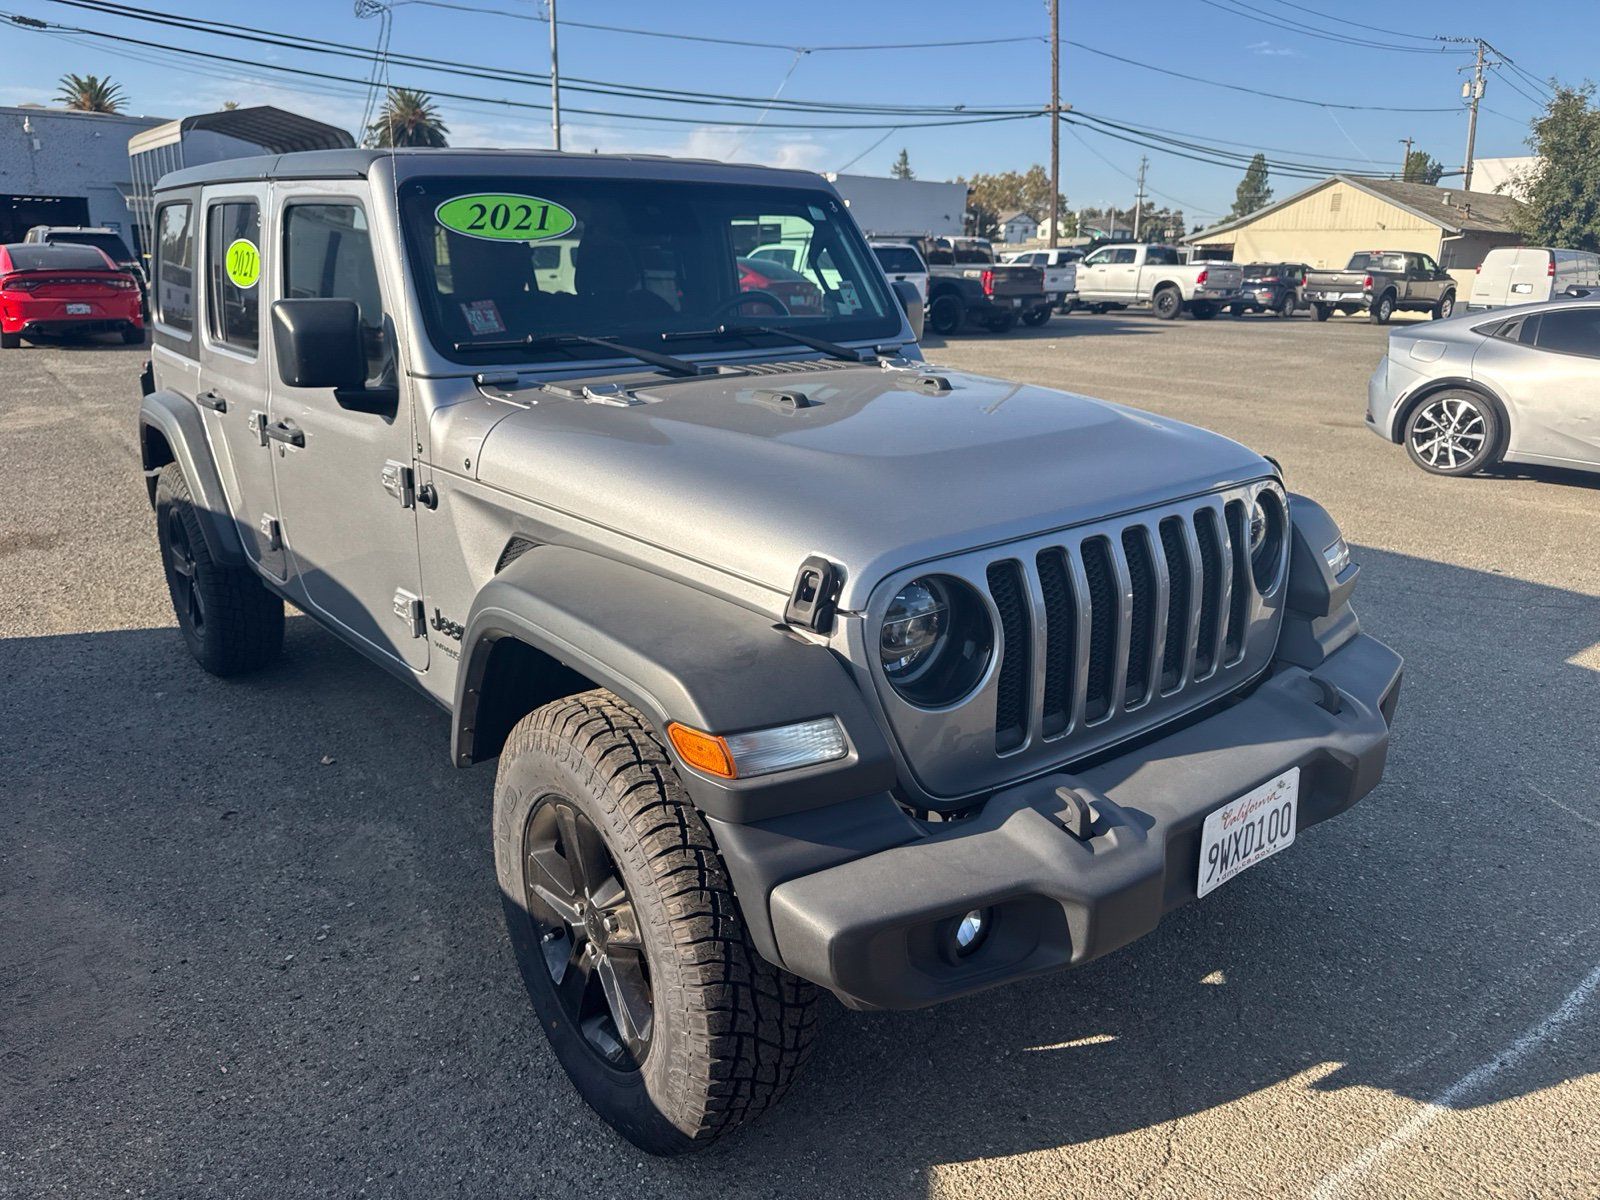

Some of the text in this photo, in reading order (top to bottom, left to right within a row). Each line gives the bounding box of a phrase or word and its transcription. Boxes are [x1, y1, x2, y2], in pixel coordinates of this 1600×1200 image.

[467, 203, 549, 231] 2021
[232, 250, 255, 278] 2021
[1223, 791, 1281, 830] California
[1206, 801, 1292, 883] 9WXD100
[1221, 847, 1271, 880] dmv.ca.gov
